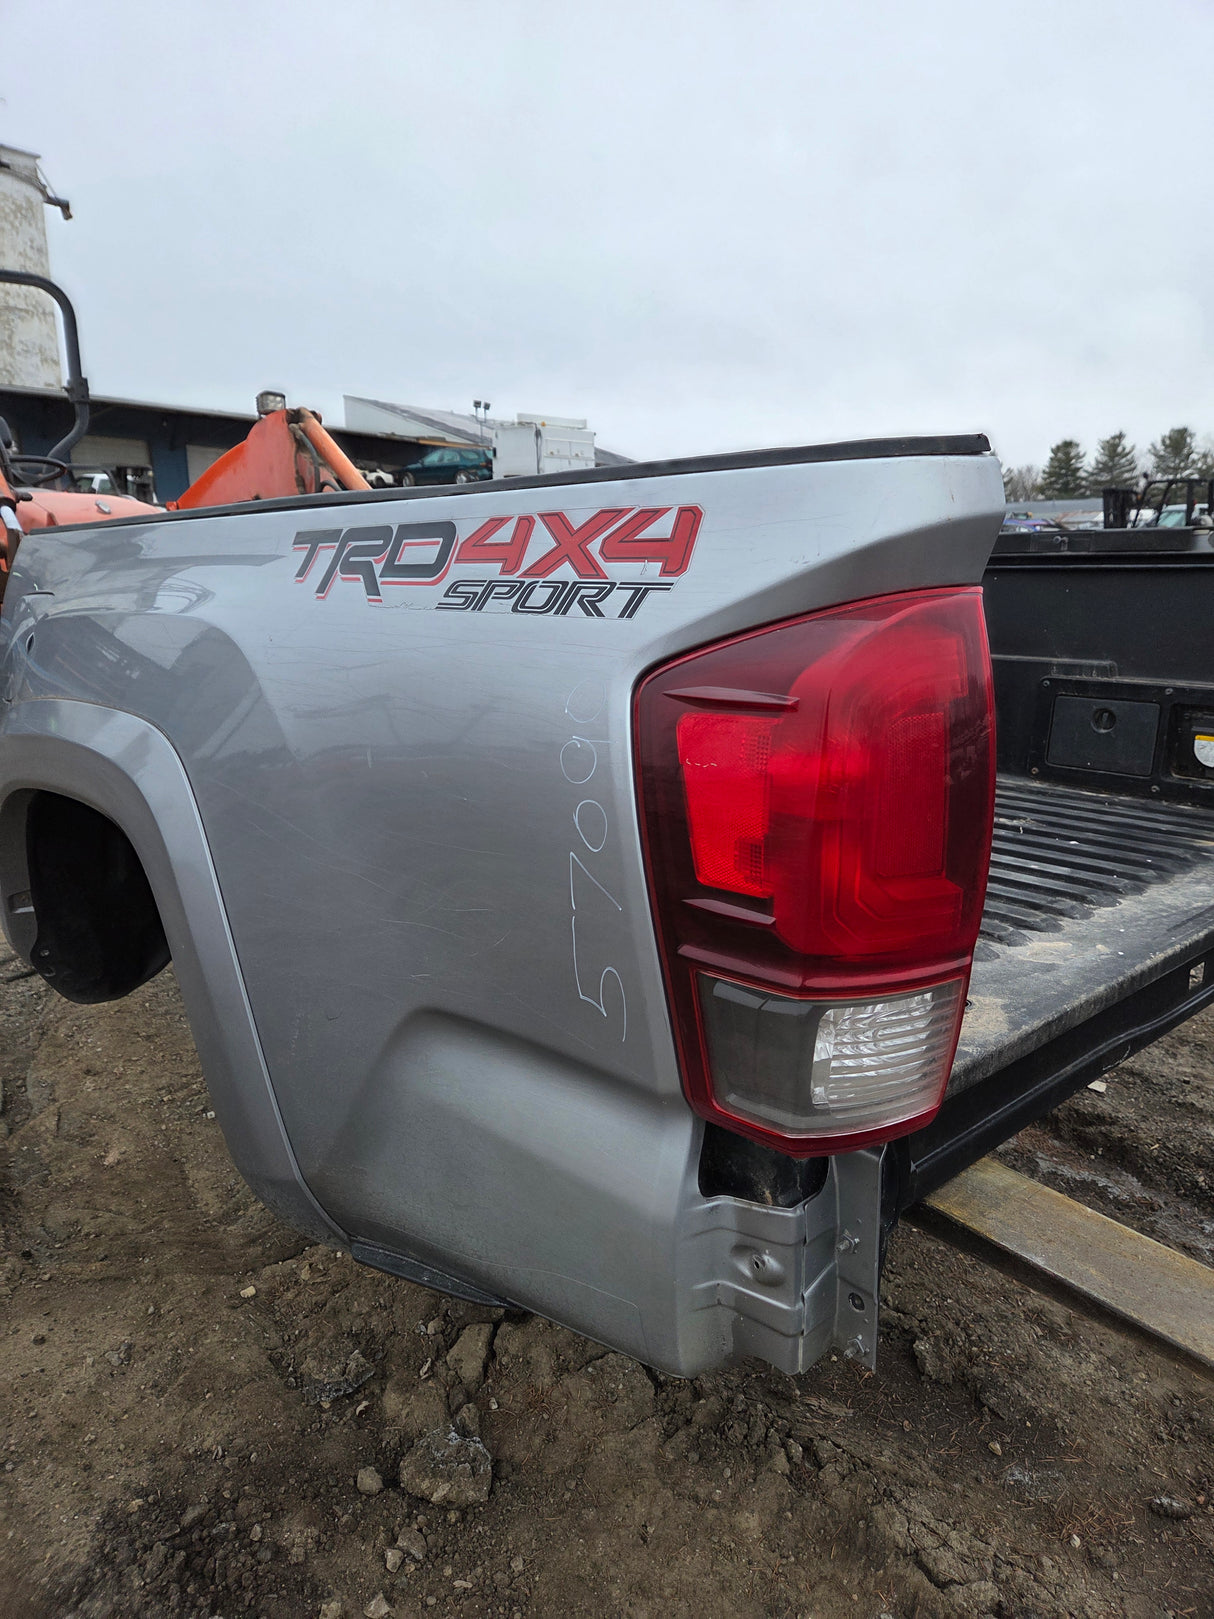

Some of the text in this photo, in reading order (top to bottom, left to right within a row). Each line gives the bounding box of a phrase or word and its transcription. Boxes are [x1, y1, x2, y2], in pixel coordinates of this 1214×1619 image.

[292, 504, 703, 603] TRD 4X4
[435, 580, 675, 619] SPORT
